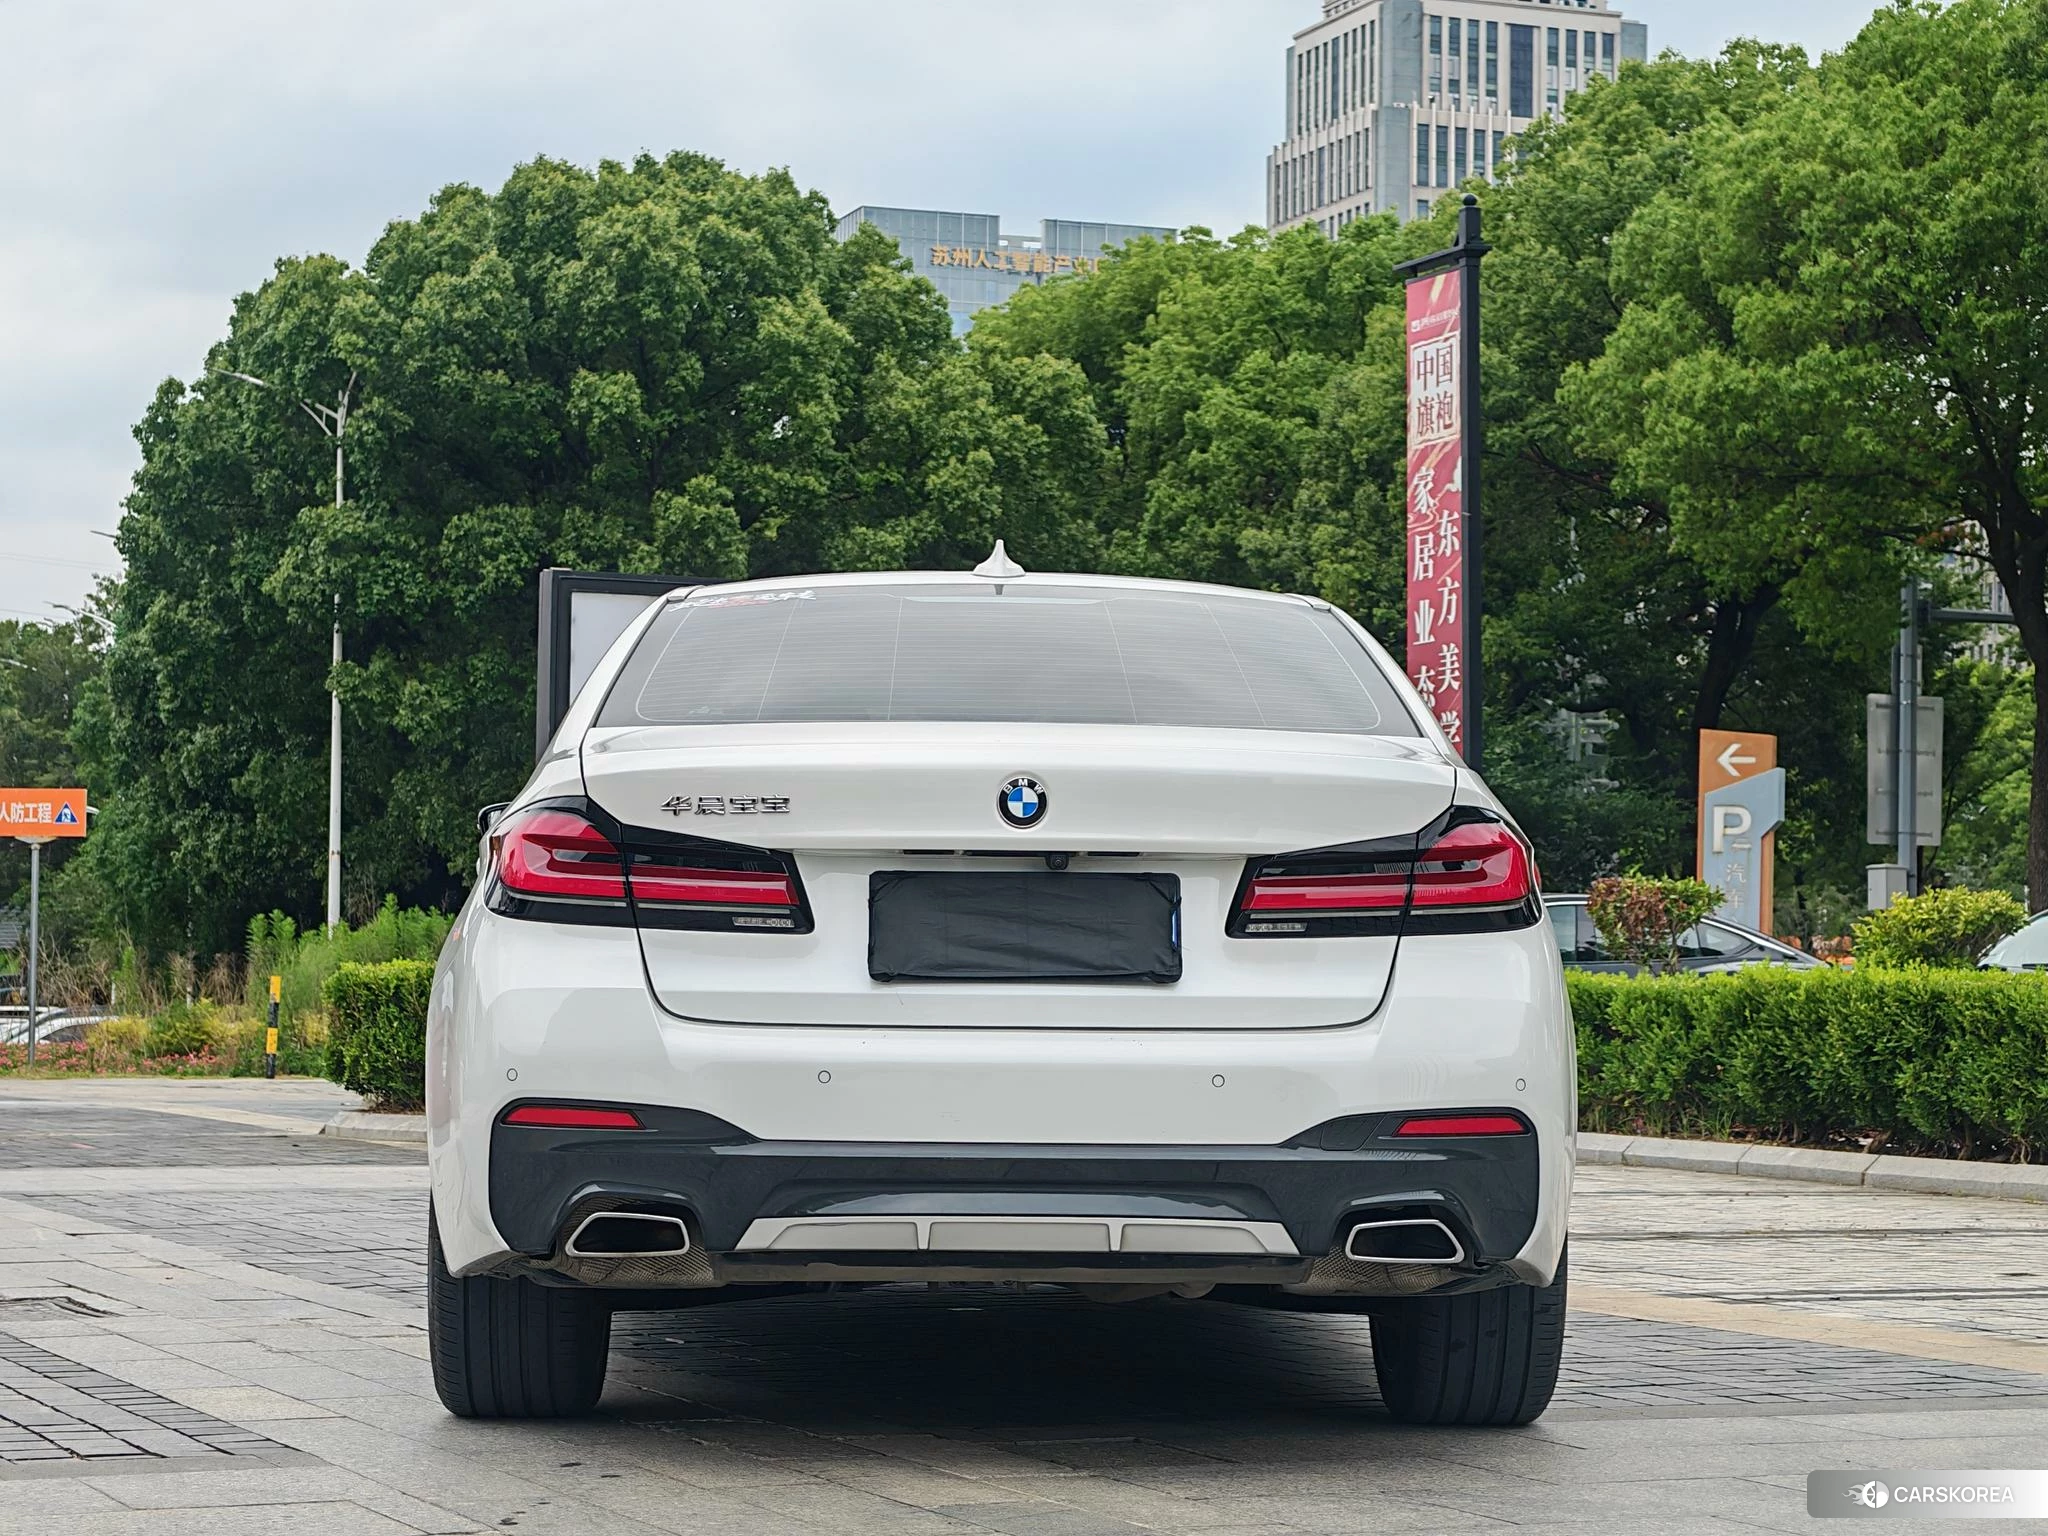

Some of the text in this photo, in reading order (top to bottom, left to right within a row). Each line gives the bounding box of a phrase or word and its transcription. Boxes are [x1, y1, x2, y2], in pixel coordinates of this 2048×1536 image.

[931, 245, 1103, 275] 苏州人工智能产业
[1416, 344, 1453, 391] 中国
[1416, 391, 1454, 437] 旗袍
[1437, 509, 1461, 743] 东方美学
[1003, 778, 1044, 795] BMW
[0, 801, 52, 823] 人防工程
[1712, 805, 1752, 854] P
[1725, 863, 1747, 922] 汽车
